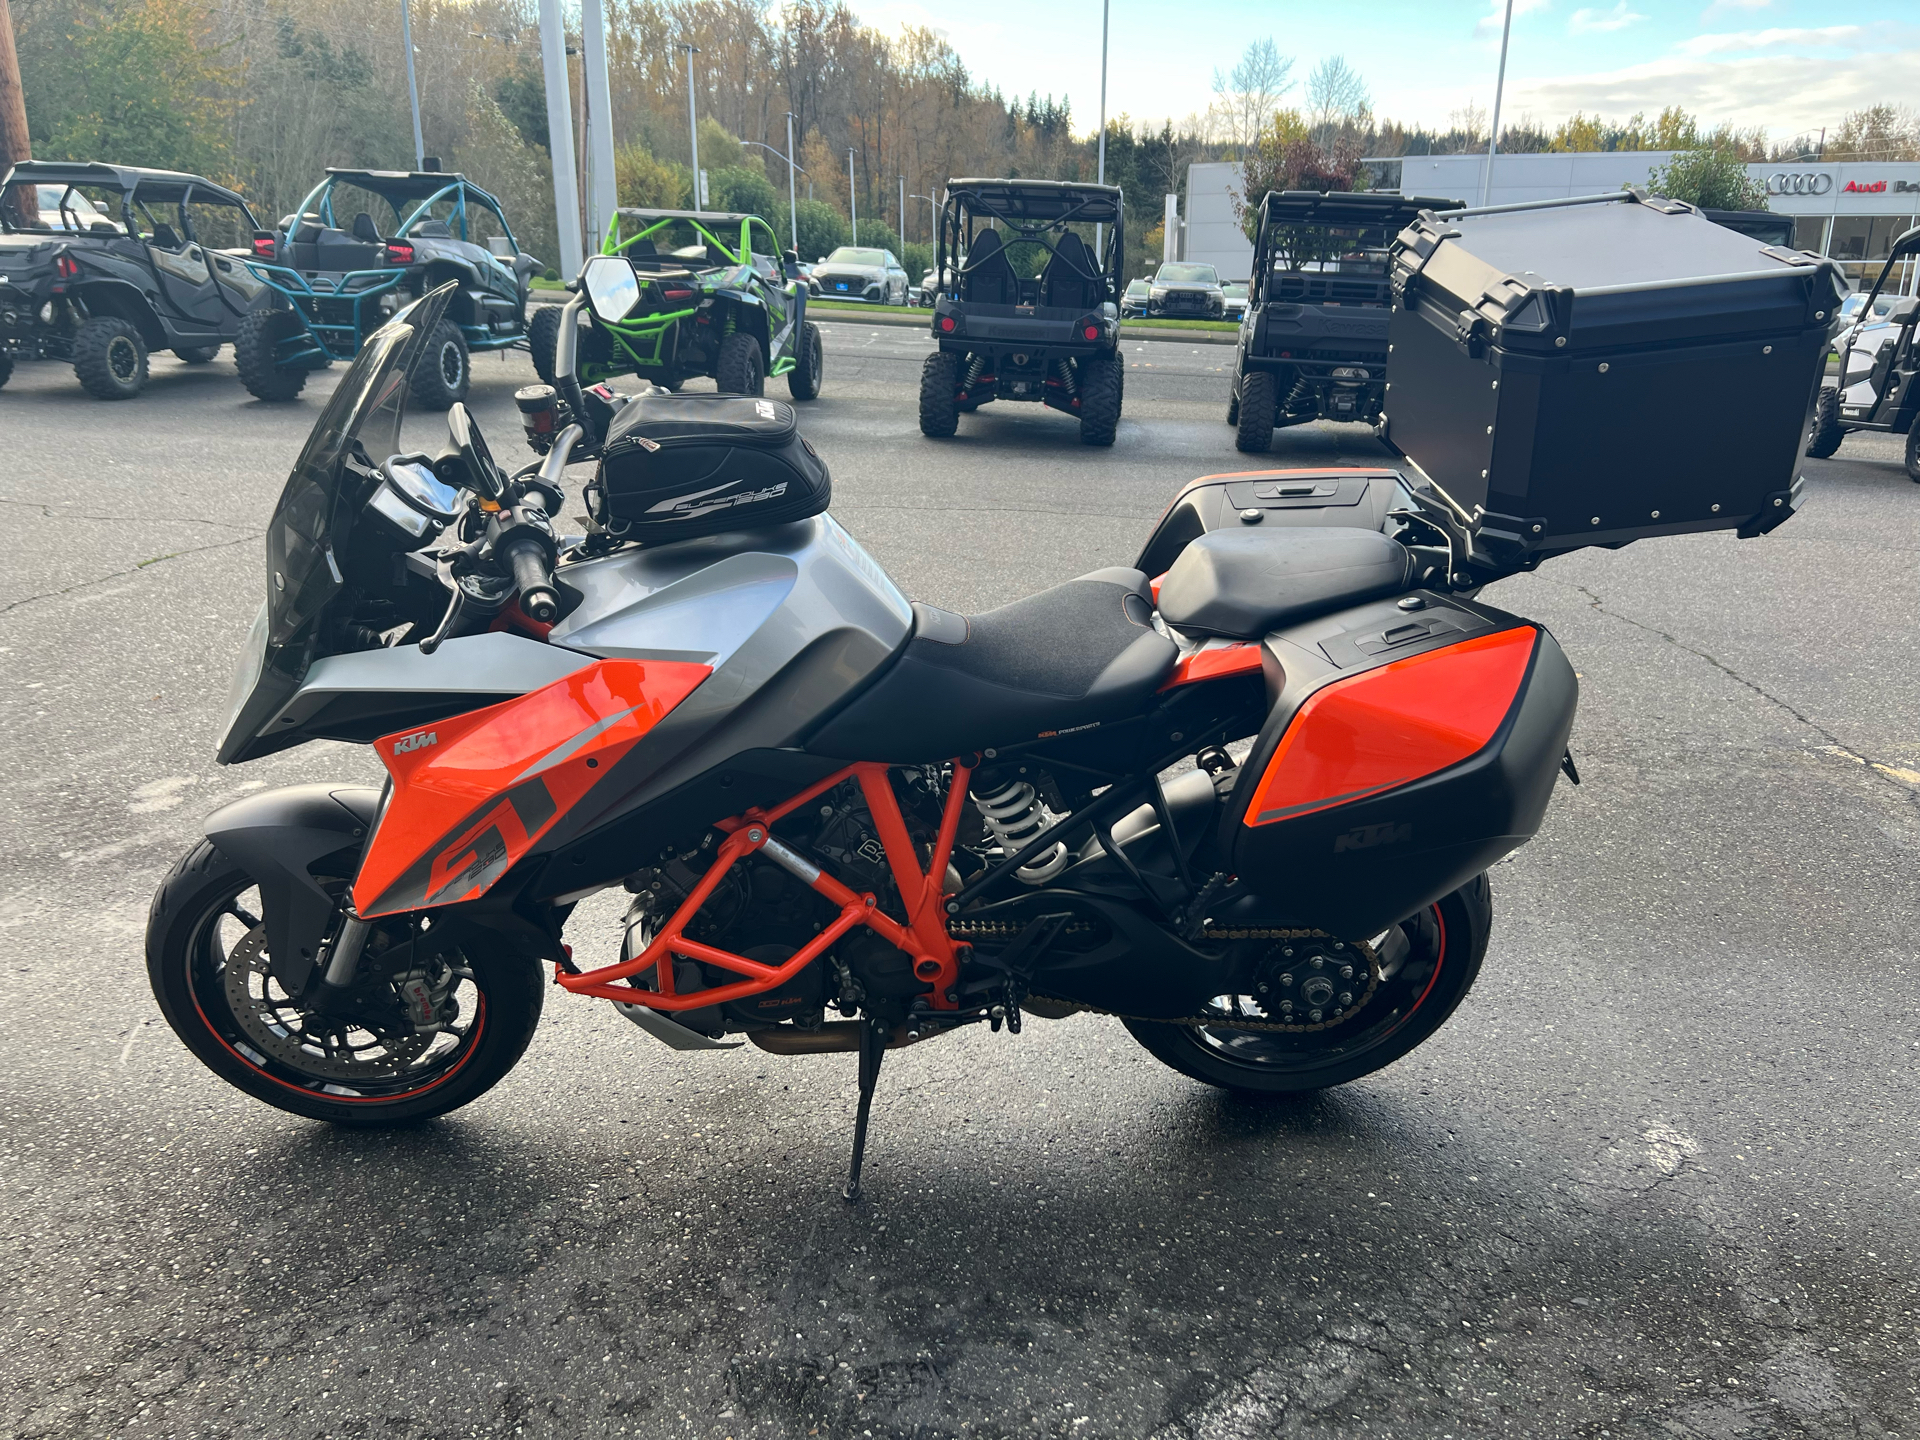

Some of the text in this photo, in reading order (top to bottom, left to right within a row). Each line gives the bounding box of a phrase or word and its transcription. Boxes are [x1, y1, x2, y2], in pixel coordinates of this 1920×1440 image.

[1844, 180, 1888, 193] Audi
[1319, 319, 1386, 336] Kawasa
[394, 731, 438, 756] KTM
[1333, 821, 1412, 853] KTM
[413, 986, 433, 1020] brembo
